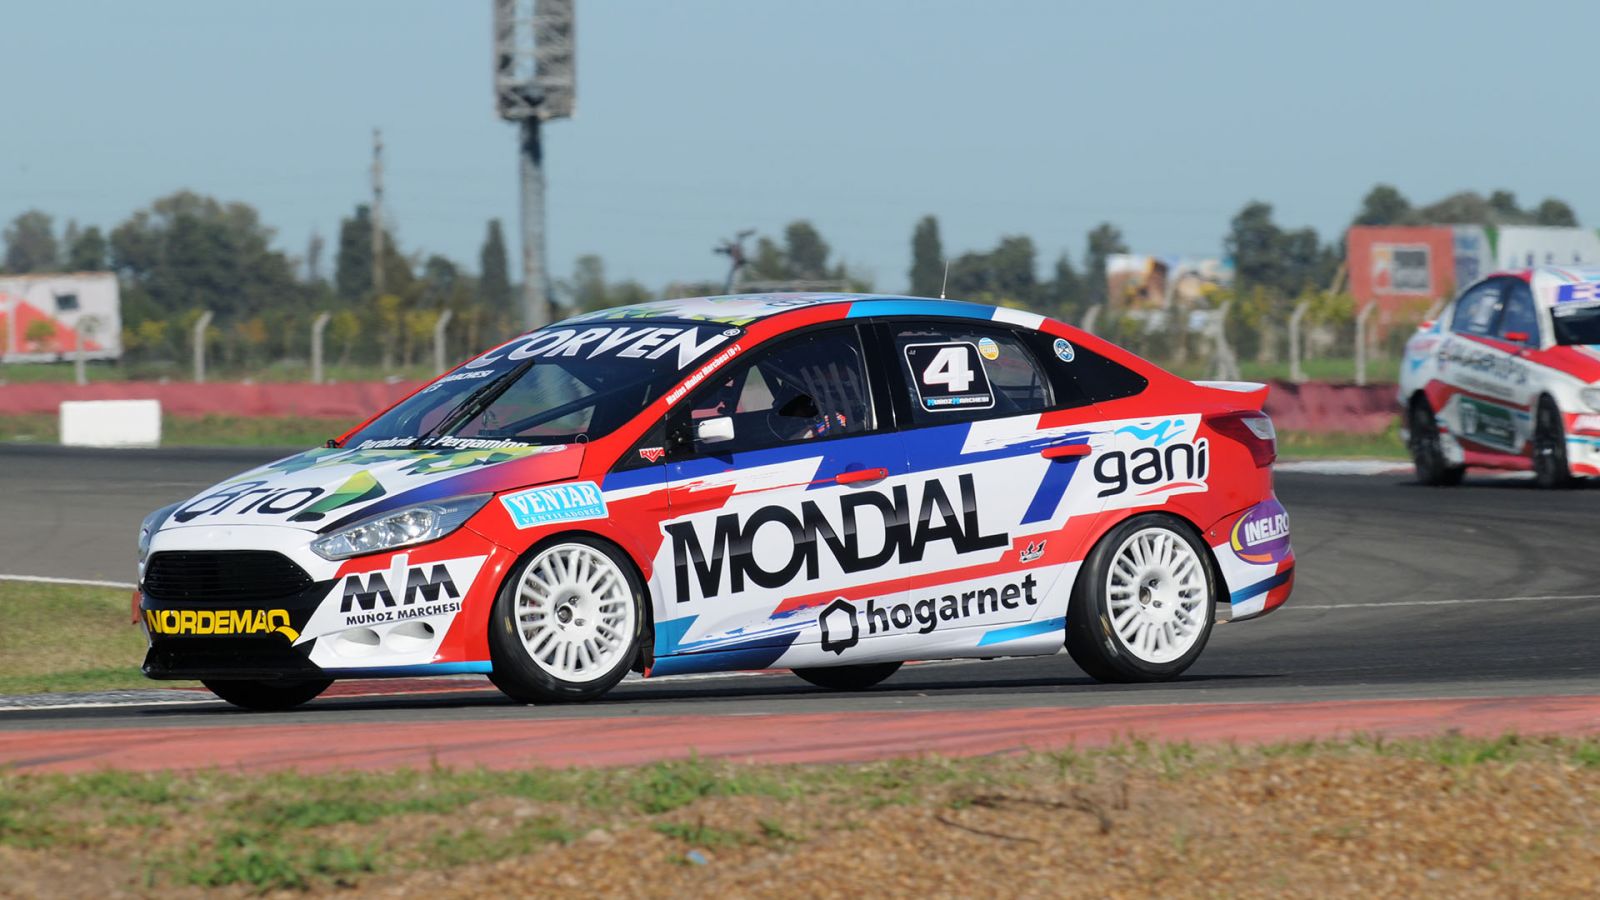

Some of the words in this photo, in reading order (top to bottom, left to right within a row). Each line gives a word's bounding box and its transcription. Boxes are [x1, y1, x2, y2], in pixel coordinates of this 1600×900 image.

[465, 326, 730, 370] CORVEN
[923, 347, 974, 391] 4
[1094, 440, 1206, 498] gani
[509, 485, 600, 515] VENTAR
[521, 507, 601, 524] VENTILADORES
[664, 473, 1009, 602] MONDIAL
[397, 602, 460, 619] MARCHESI
[867, 573, 1038, 634] hogarnet
[146, 608, 301, 644] NORDEMAQ
